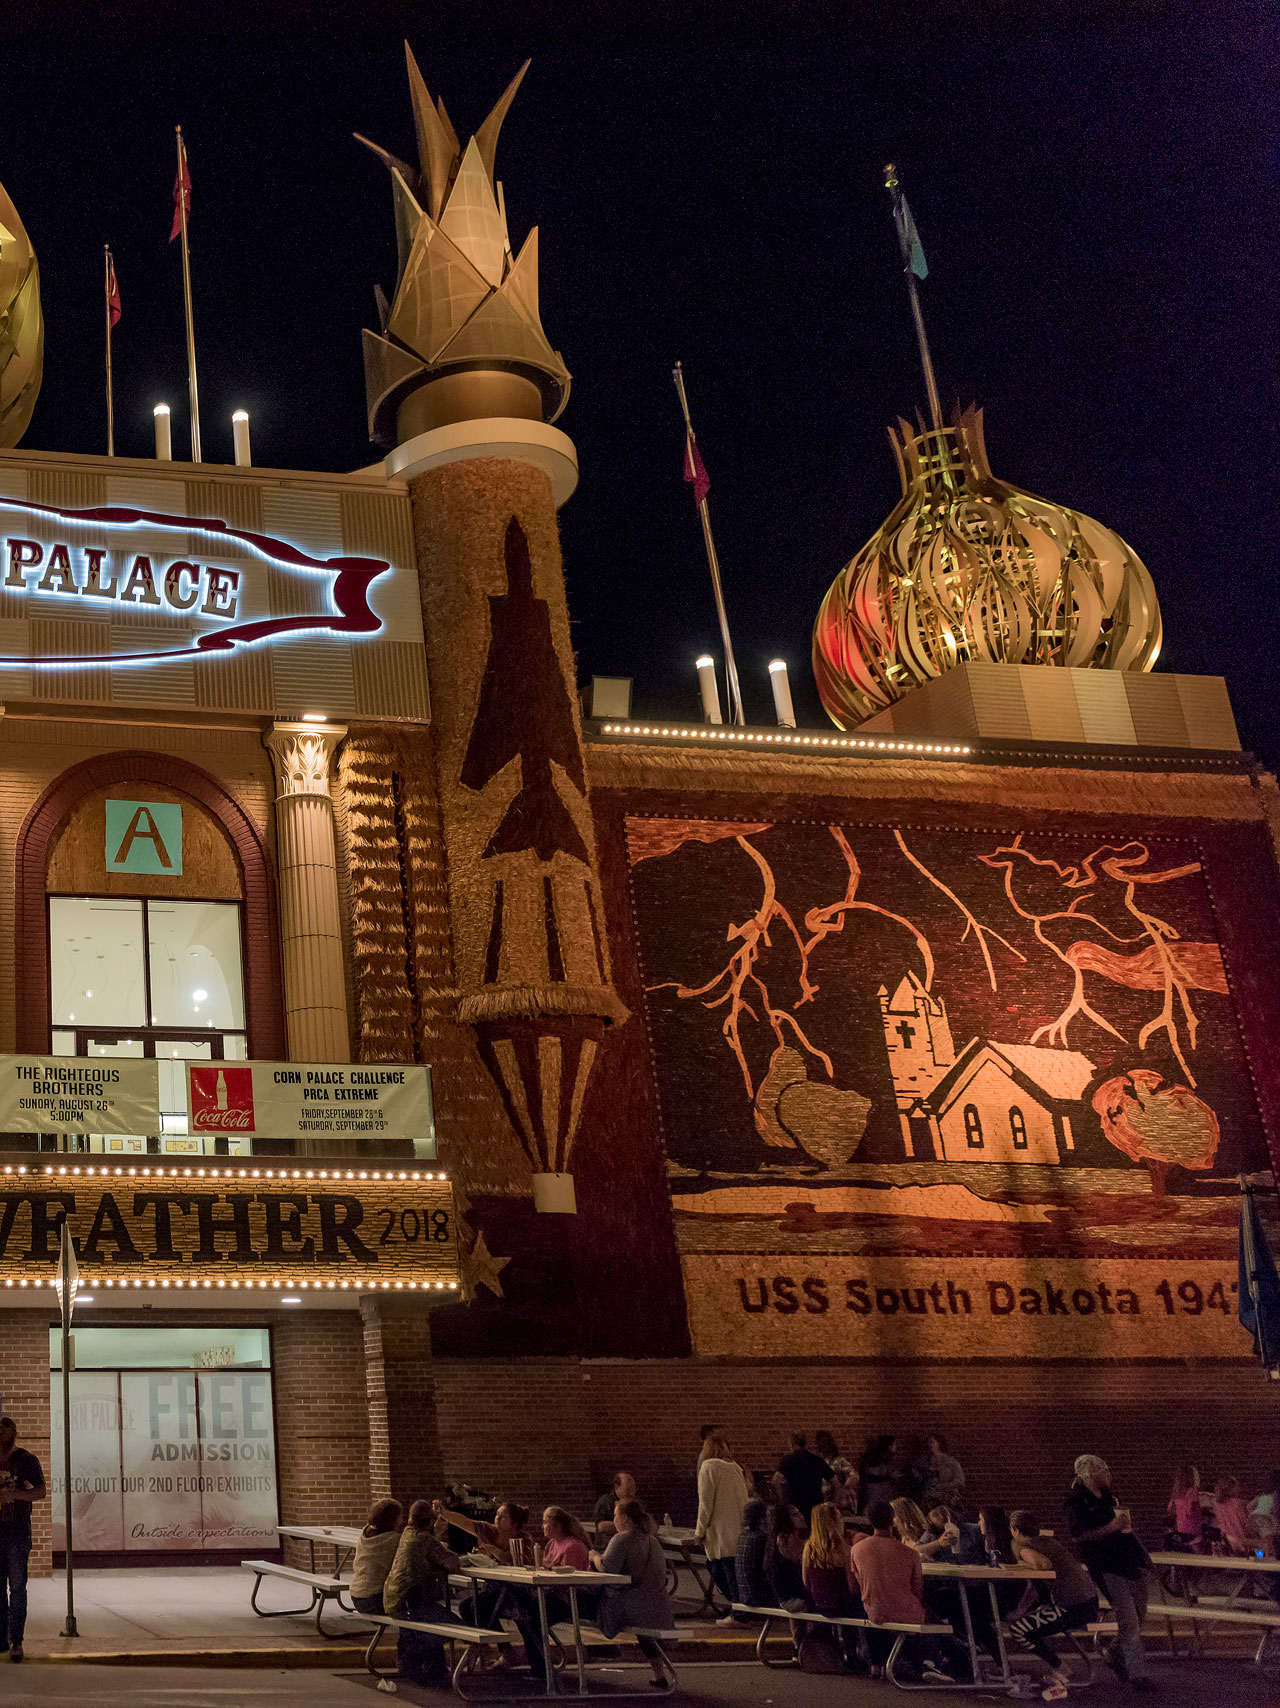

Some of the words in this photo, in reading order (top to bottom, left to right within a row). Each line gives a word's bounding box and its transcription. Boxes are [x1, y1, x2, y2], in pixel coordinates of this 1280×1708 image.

[3, 536, 241, 620] PALACE
[114, 806, 173, 868] A
[15, 1066, 40, 1080] THE
[44, 1067, 120, 1082] RIGHTEOUS
[273, 1071, 302, 1084] CORN
[307, 1072, 345, 1084] PALACE
[350, 1072, 405, 1085] CHALLENGE
[33, 1081, 103, 1096] BROTHERS
[303, 1088, 330, 1100] PRCA
[335, 1088, 379, 1100] EXTREME
[19, 1098, 57, 1110] SUNDAY,
[59, 1099, 94, 1110] AUGUST
[50, 1110, 84, 1121] 5:00PM
[193, 1108, 253, 1129] Coca-Cola
[298, 1120, 335, 1131] SATURDAY,
[336, 1121, 373, 1131] SEPTEMBER
[377, 1207, 451, 1245] 2018
[737, 1276, 830, 1315] USS
[845, 1279, 973, 1316] South
[988, 1279, 1140, 1317] Dakota
[1155, 1280, 1240, 1317] 194
[54, 1403, 88, 1431] CRN
[148, 1375, 269, 1440] FREE
[150, 1443, 270, 1462] ADMISSION
[94, 1477, 118, 1493] OUT
[121, 1477, 145, 1493] OUR
[149, 1477, 173, 1493] 2ND
[176, 1477, 214, 1493] FLOOR
[217, 1476, 272, 1493] EXHIBITS
[131, 1522, 185, 1539] Outside
[187, 1524, 275, 1543] expectations
